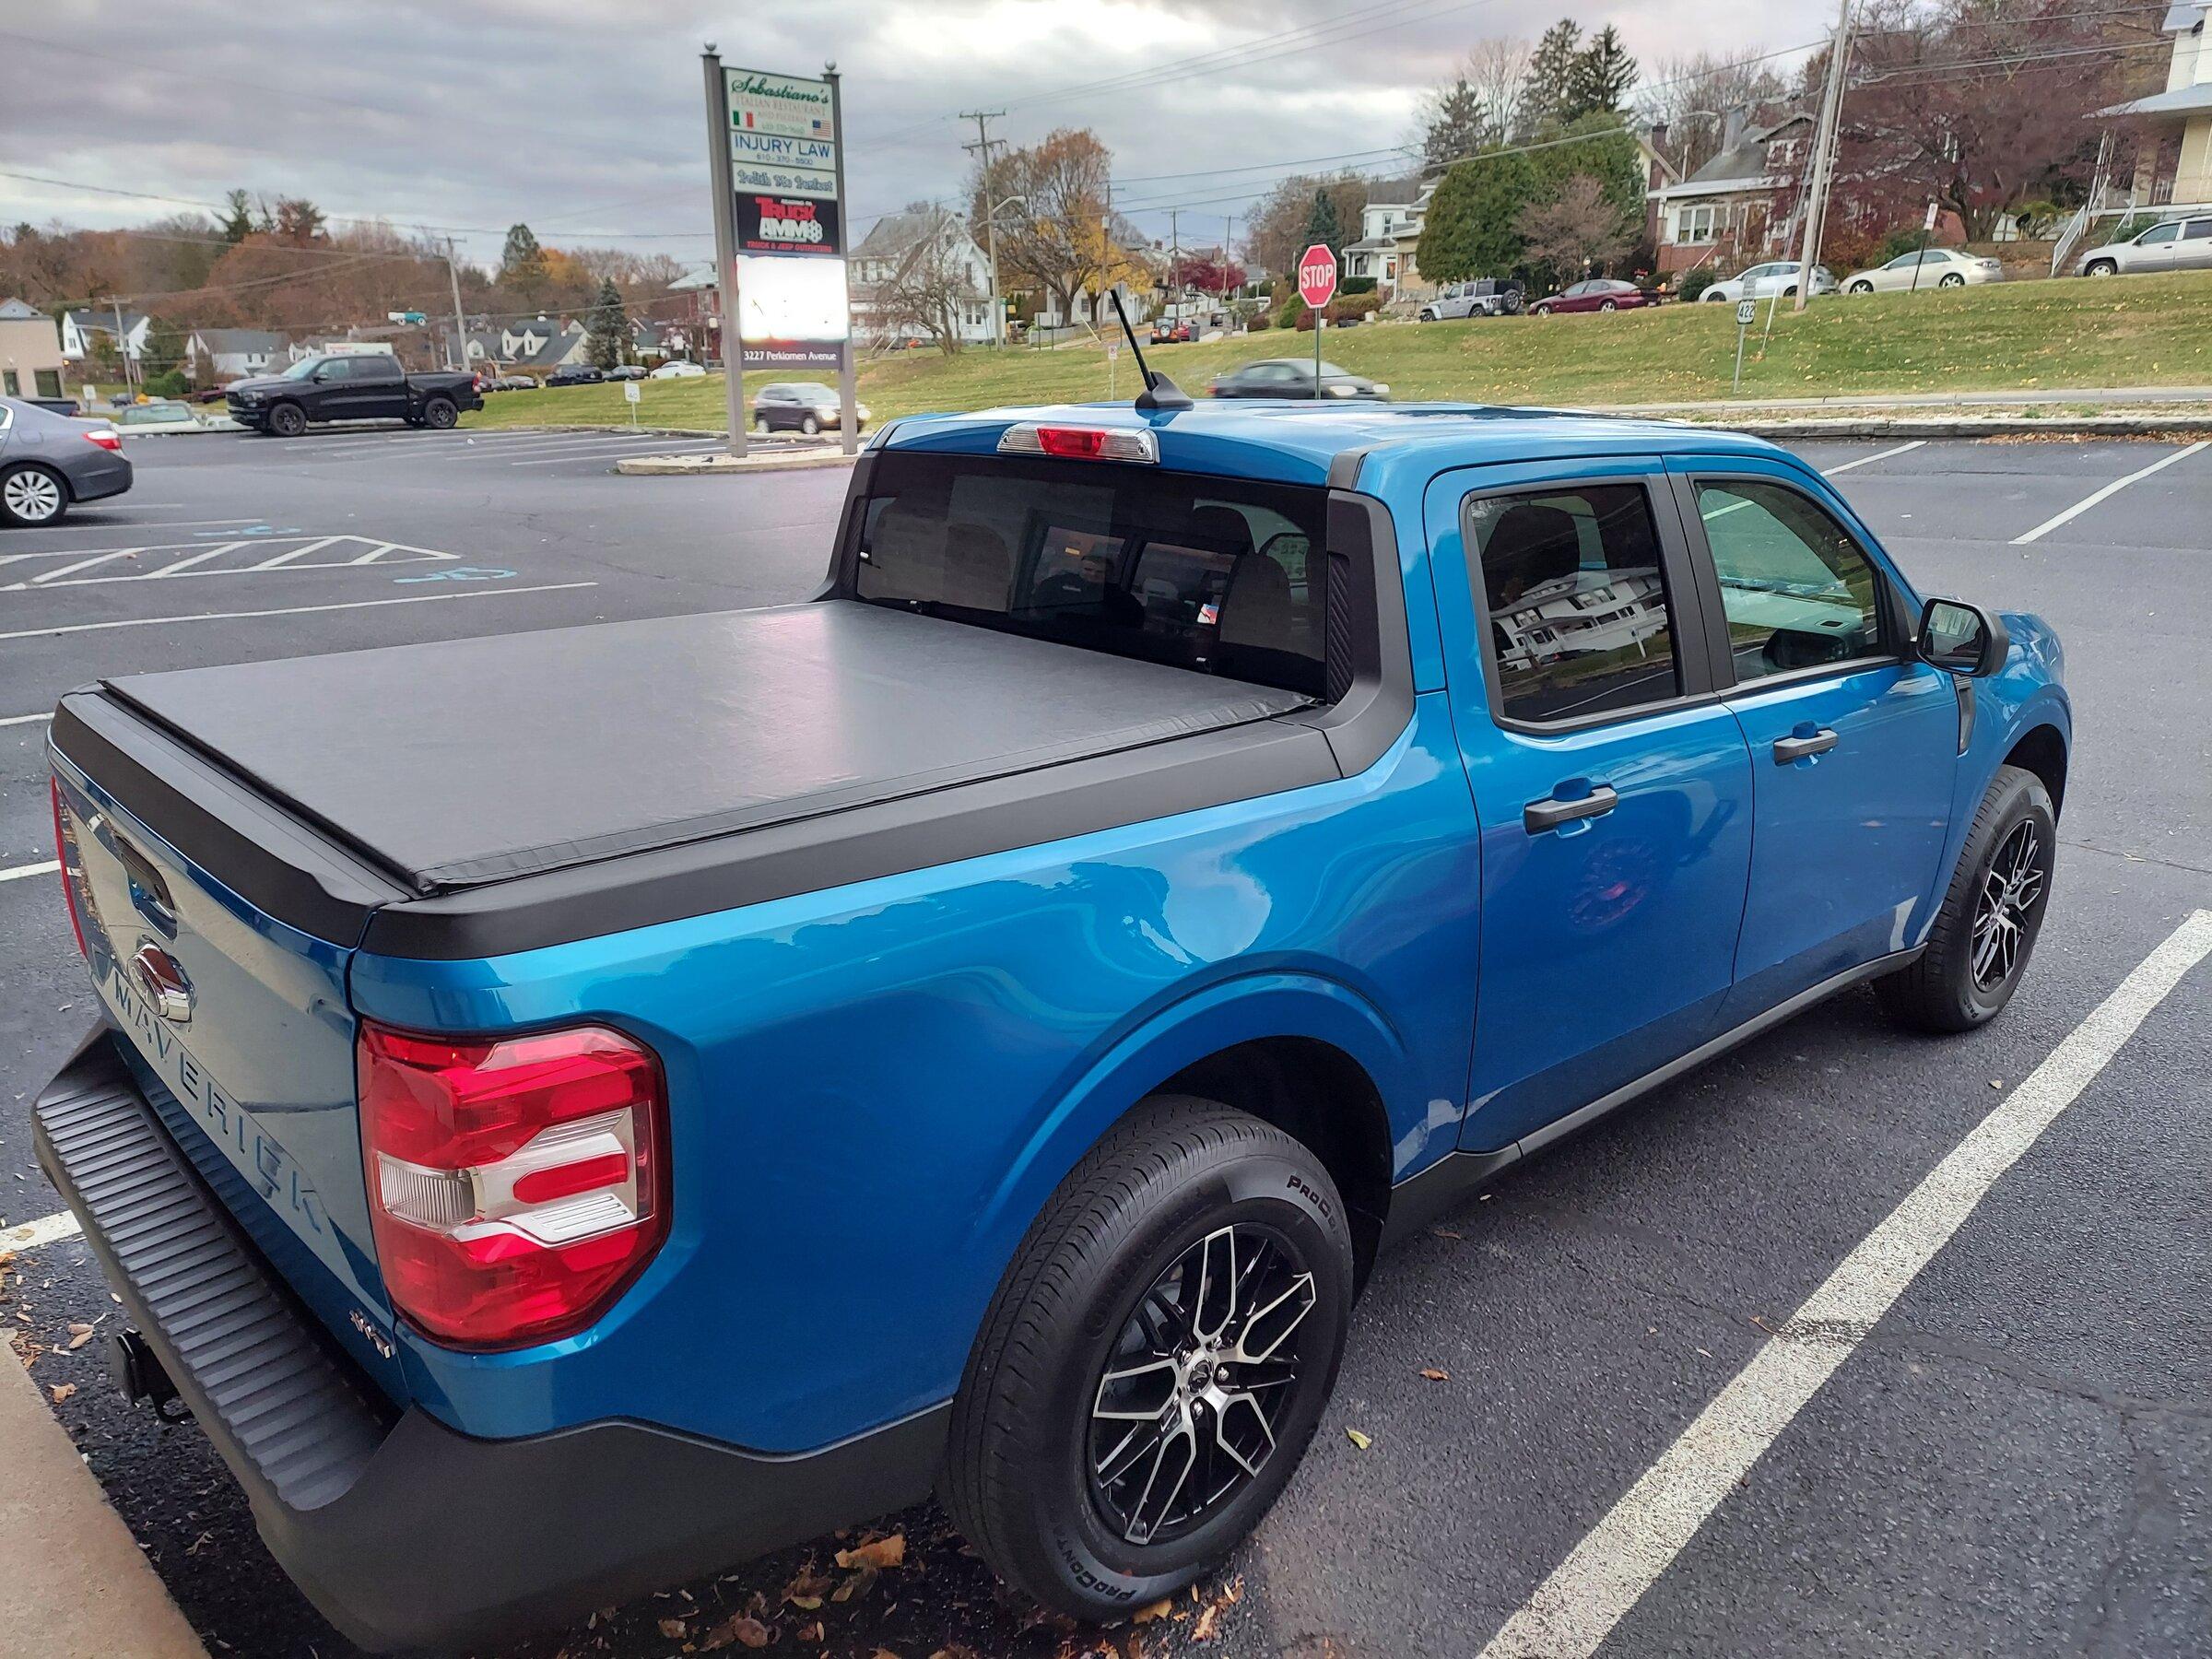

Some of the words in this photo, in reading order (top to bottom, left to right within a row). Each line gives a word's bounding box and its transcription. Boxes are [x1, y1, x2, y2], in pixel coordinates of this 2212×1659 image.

[732, 76, 829, 104] Sebastiano's
[735, 134, 793, 153] INJURY
[798, 142, 830, 158] LAW
[1301, 264, 1335, 289] STOP
[1738, 304, 1755, 318] 422
[744, 351, 765, 360] 3227
[766, 351, 807, 360] Perkiomen
[807, 352, 837, 360] Avenue
[114, 970, 323, 1236] MAVERICK
